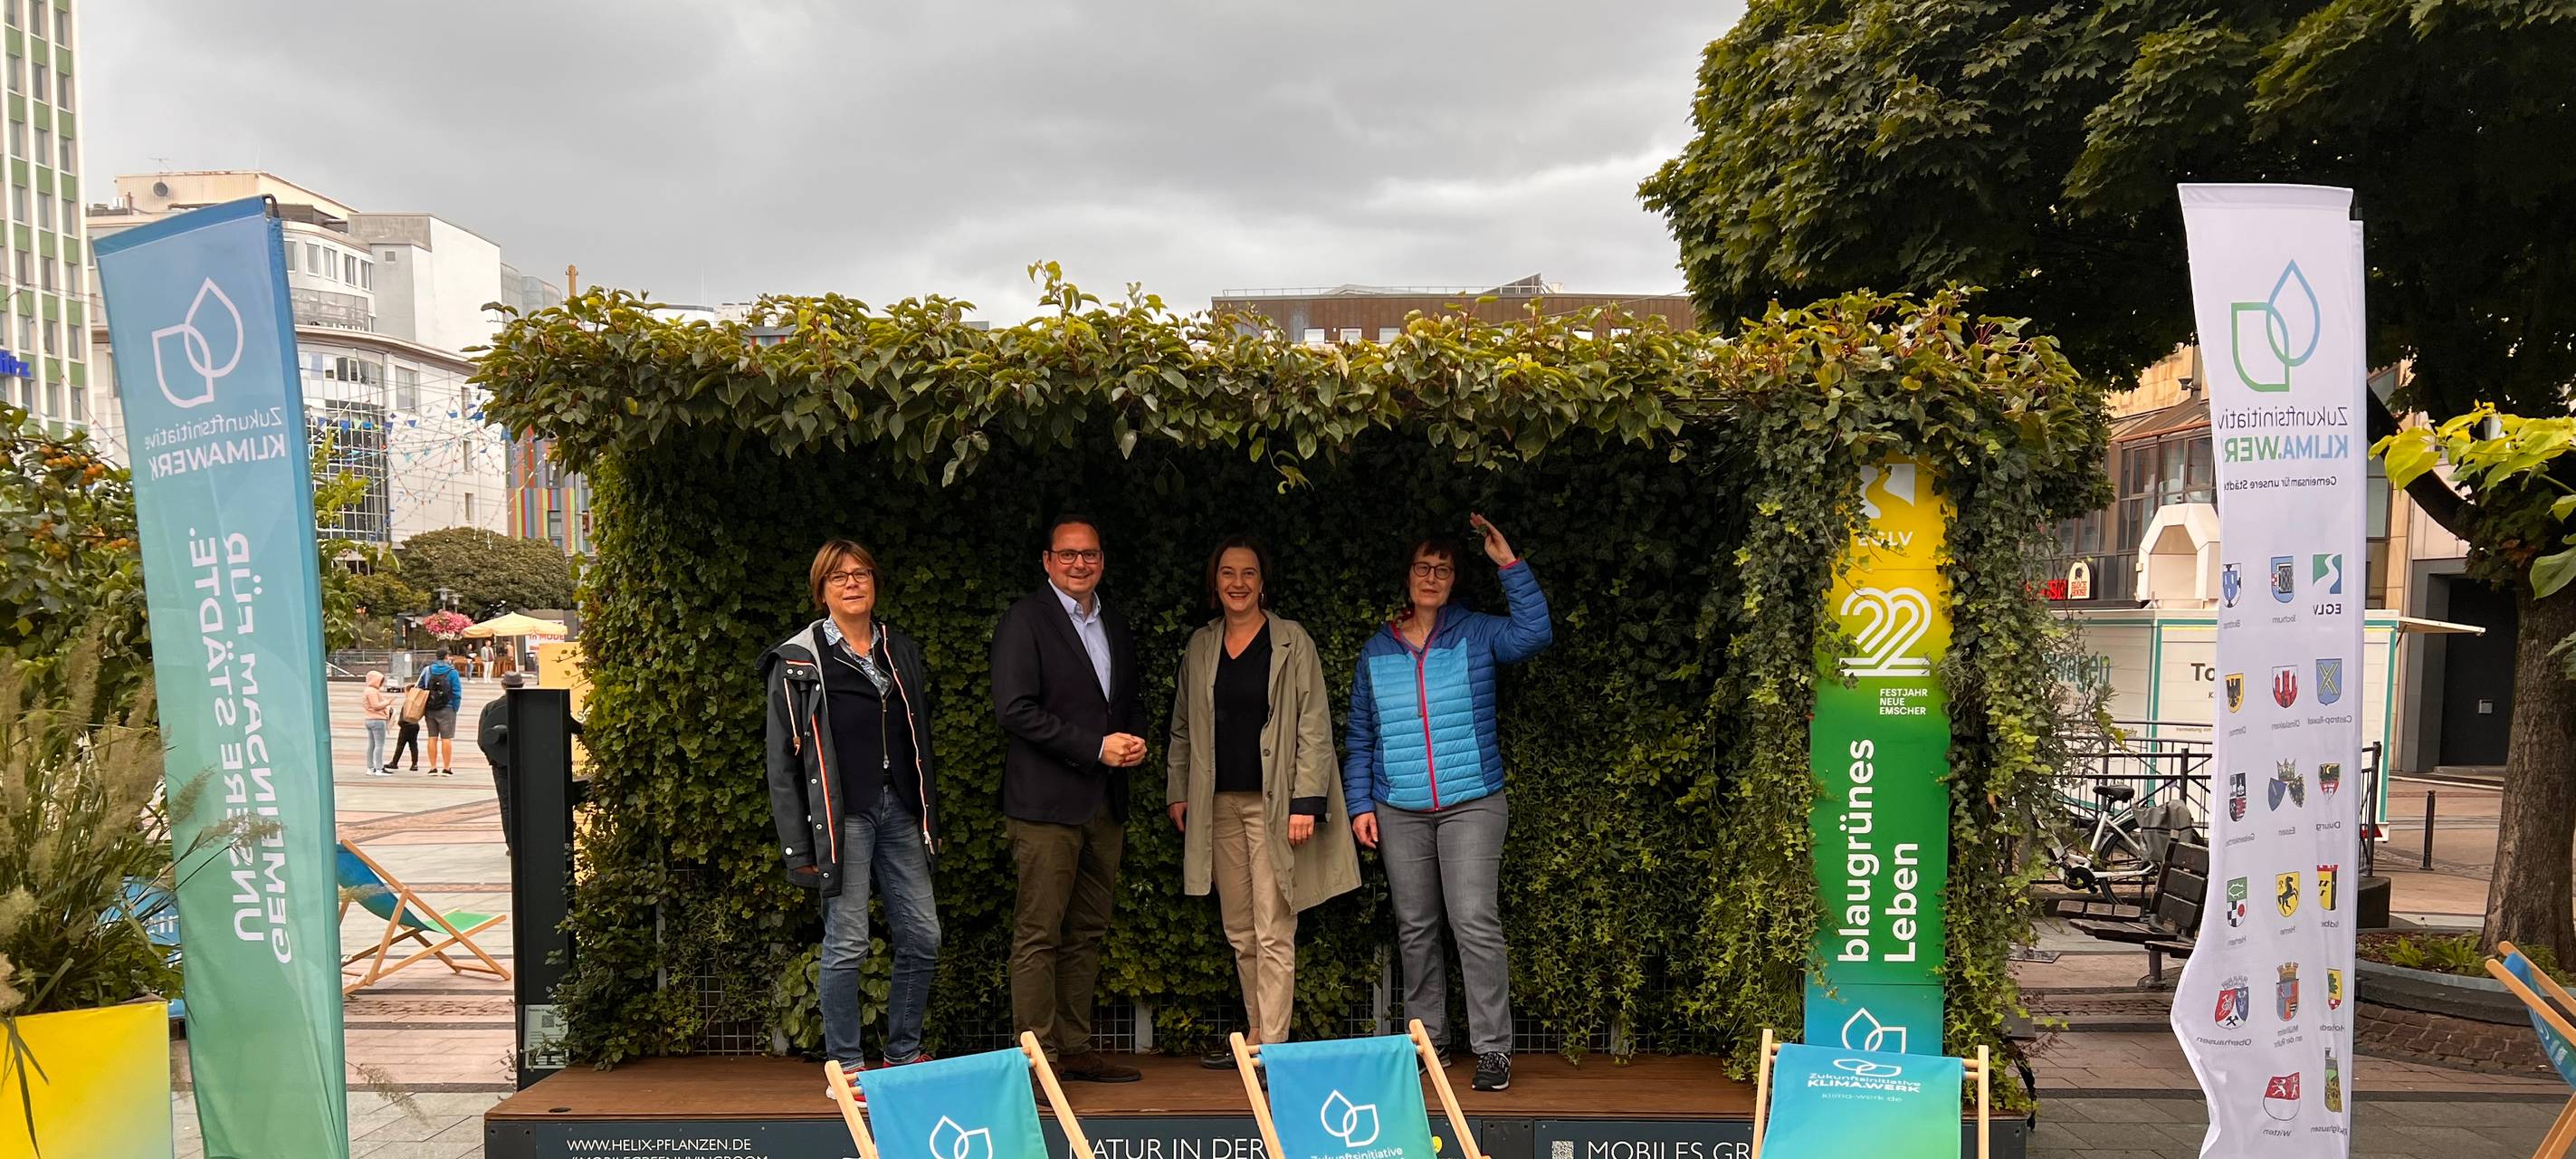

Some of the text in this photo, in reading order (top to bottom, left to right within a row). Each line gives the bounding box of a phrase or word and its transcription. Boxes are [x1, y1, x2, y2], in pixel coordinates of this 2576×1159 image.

[1880, 688, 1928, 697] FESTJAHR
[1880, 697, 1905, 706] NEUE
[1880, 706, 1927, 715] EMSCHER
[1837, 739, 1880, 962] blaugrünes
[1884, 843, 1919, 962] Leben
[567, 1139, 751, 1151] WWW.HELIX-PFLANZEN.DE
[1173, 1138, 1201, 1159] IN
[1213, 1138, 1265, 1159] DER
